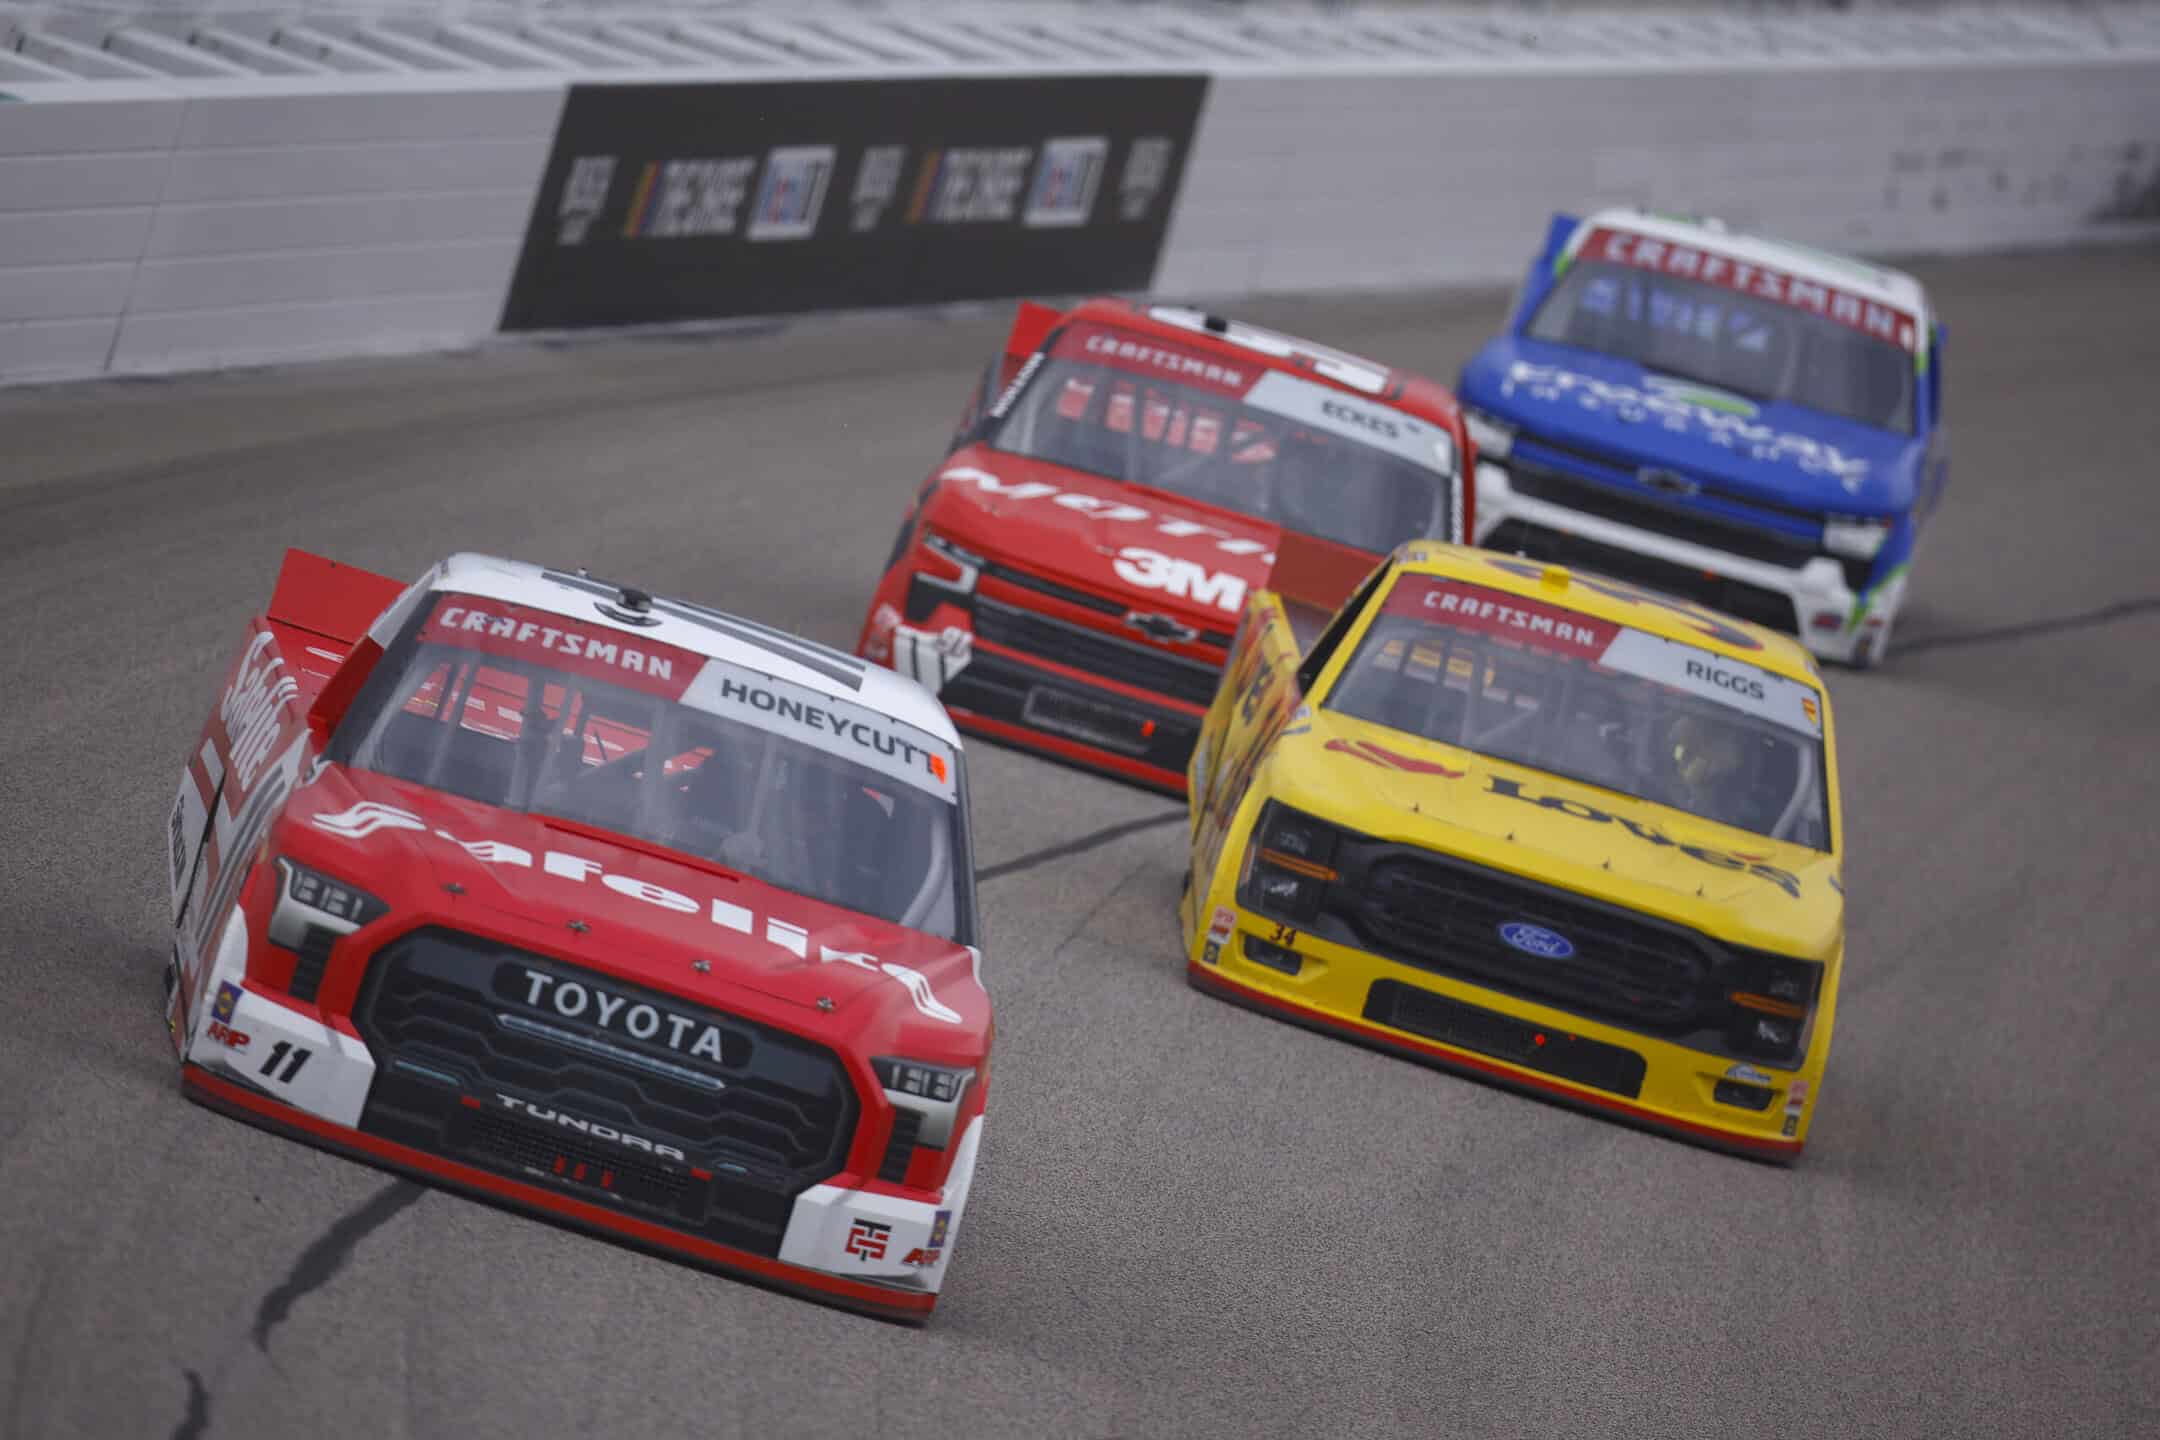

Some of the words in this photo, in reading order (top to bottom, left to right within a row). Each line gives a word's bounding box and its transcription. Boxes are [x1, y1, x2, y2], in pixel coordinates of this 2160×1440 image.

[1604, 231, 1895, 342] CRAFTSMAN
[1086, 335, 1242, 387] CRAFTSMAN
[1113, 547, 1248, 612] 3M
[440, 607, 672, 681] CRAFTSMAN
[1424, 591, 1594, 646] CRAFTSMAN
[1686, 659, 1765, 700] RIGGS
[721, 678, 936, 776] HONEYCUTT
[311, 800, 963, 1024] Safelite
[1270, 921, 1297, 947] 34
[1511, 926, 1562, 952] Ford
[525, 969, 723, 1062] TOYOTA
[259, 1039, 313, 1085] 11
[496, 1092, 685, 1161] TUNDRA
